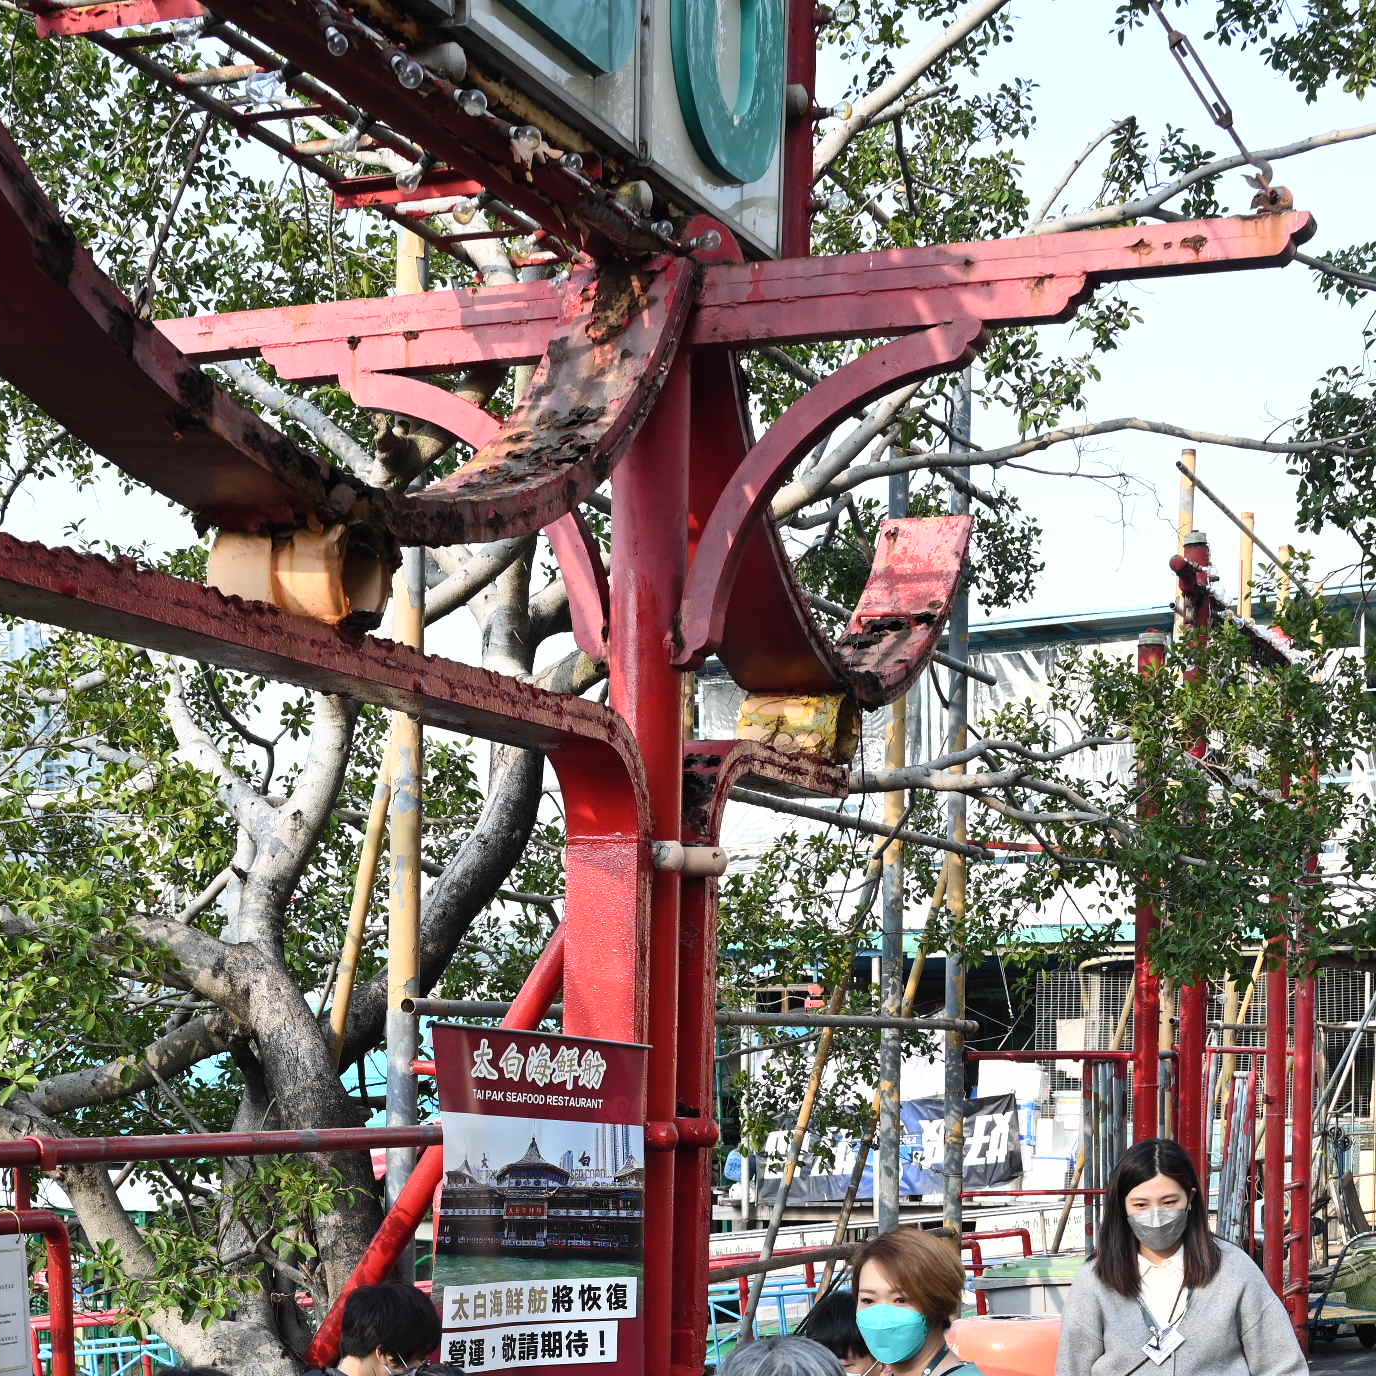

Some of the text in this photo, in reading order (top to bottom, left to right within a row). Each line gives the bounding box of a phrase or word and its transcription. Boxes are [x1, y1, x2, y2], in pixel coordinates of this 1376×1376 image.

[470, 1038, 607, 1091] 太白海鮮舫
[473, 1088, 603, 1109] TAI PAK SEAFOOD RESTAURANT
[450, 1282, 628, 1322] 太白海鮮舫將恢復
